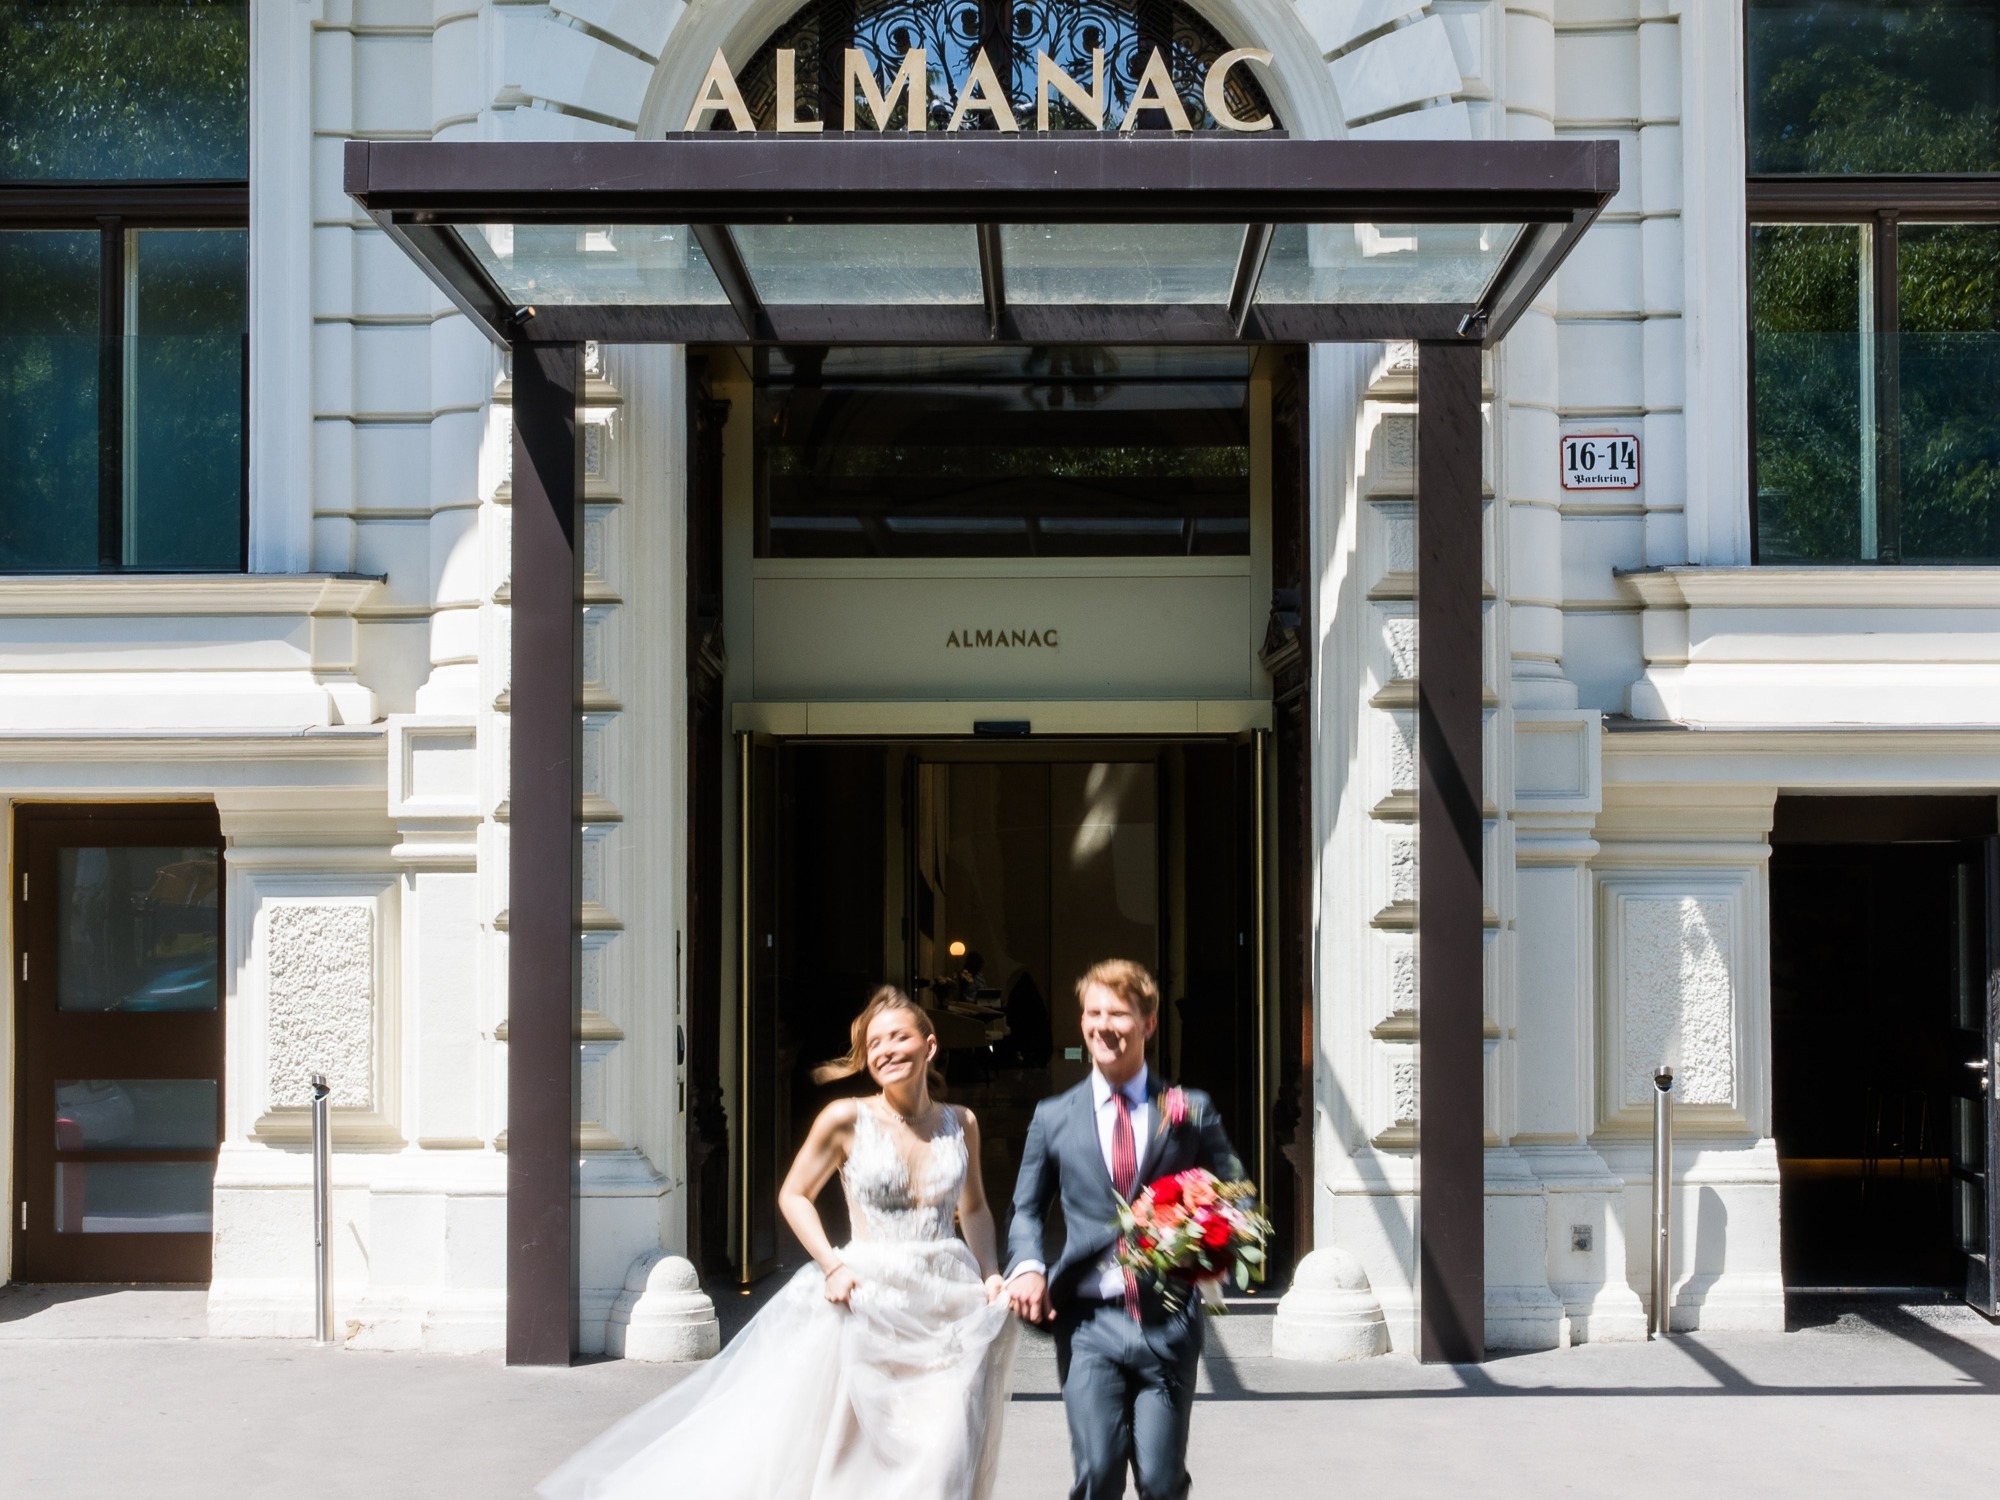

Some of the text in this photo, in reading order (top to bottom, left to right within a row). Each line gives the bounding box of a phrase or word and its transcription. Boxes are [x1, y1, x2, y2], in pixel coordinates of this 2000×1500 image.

[683, 47, 1274, 132] ALMANAC
[1566, 441, 1636, 471] 16-14
[1574, 474, 1627, 485] Parkring
[946, 629, 1058, 648] ALMANAC
